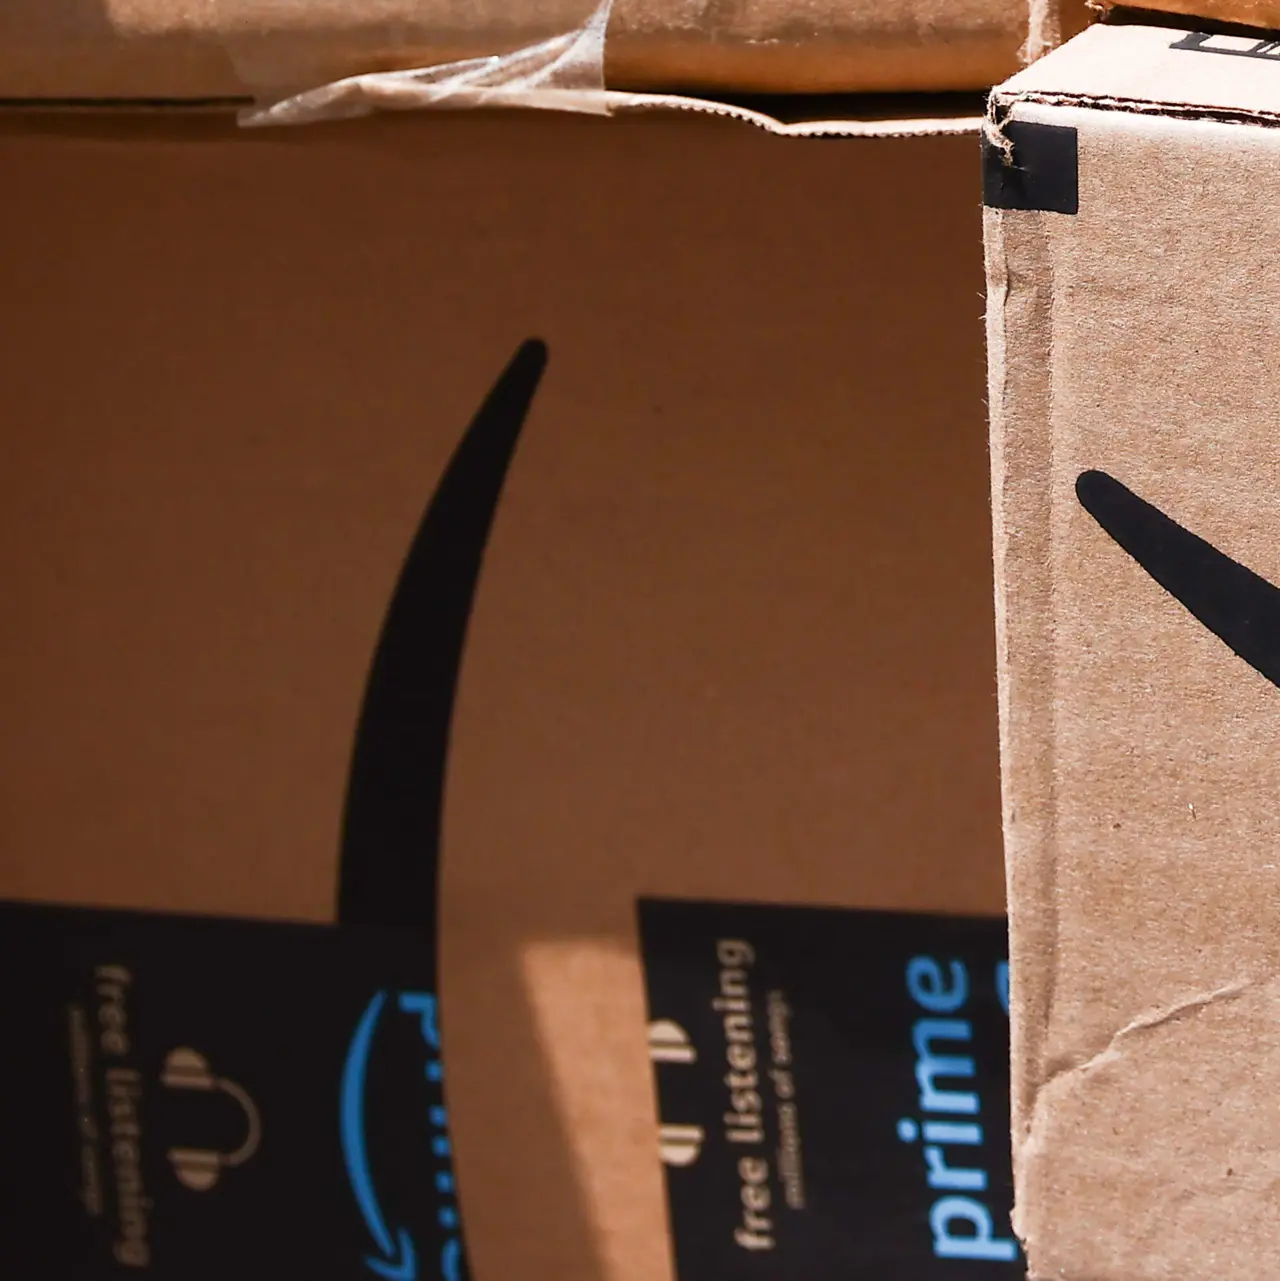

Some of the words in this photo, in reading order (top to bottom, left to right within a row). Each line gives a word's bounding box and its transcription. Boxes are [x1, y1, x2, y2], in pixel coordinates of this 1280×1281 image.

[712, 938, 764, 1144] listening
[897, 955, 1017, 1261] prime
[735, 1156, 776, 1251] free
